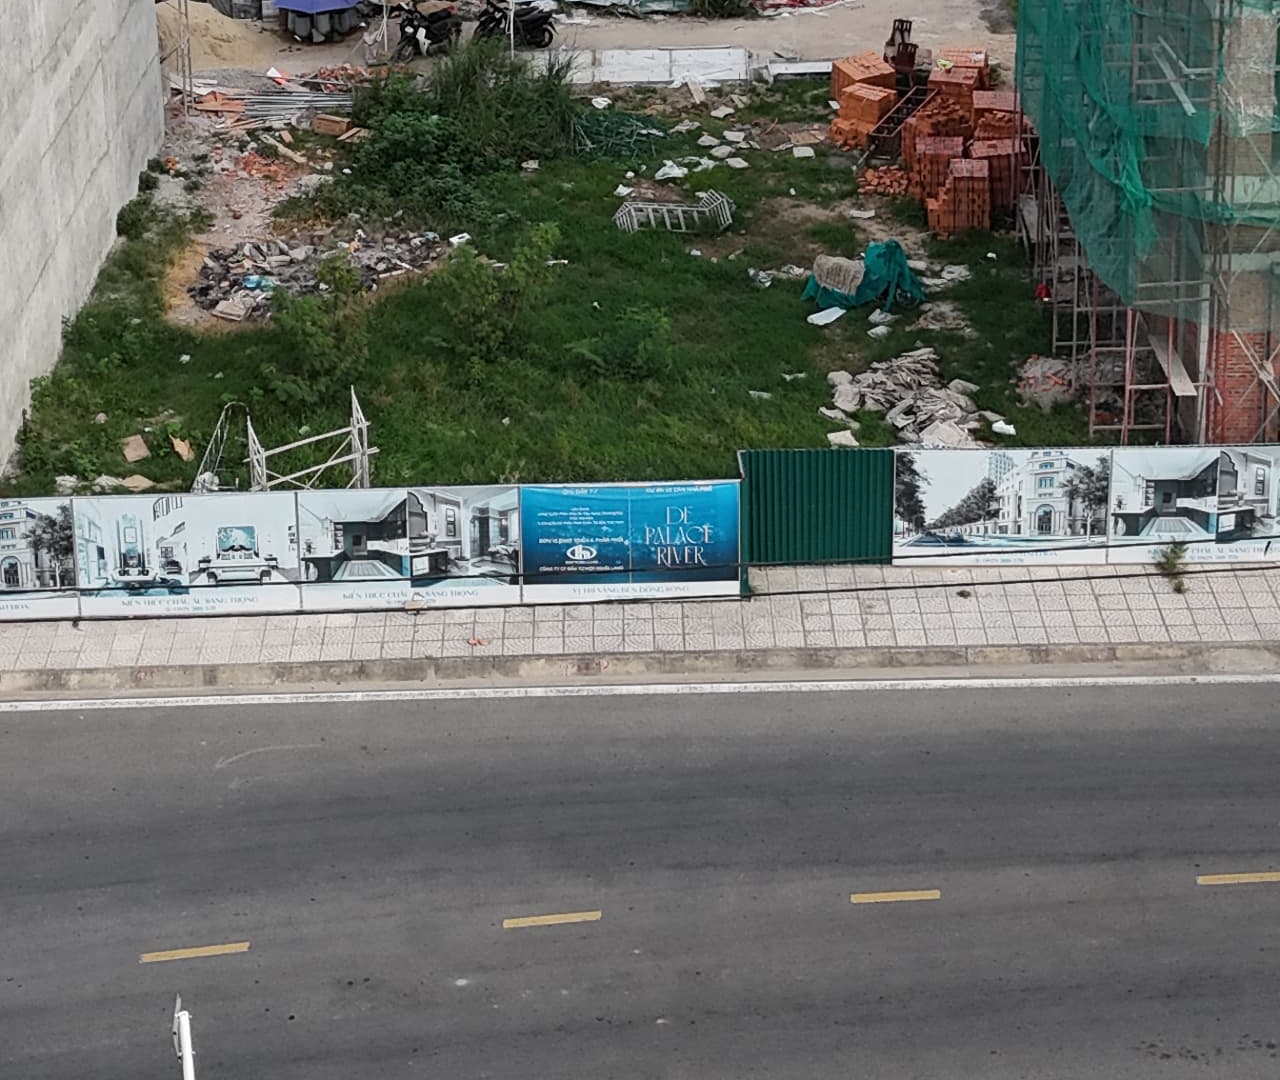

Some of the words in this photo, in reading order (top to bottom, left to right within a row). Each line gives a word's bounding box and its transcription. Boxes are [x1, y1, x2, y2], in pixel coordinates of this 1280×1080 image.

[666, 506, 694, 524] DE
[644, 522, 714, 546] PALACE
[657, 546, 709, 568] RIVER
